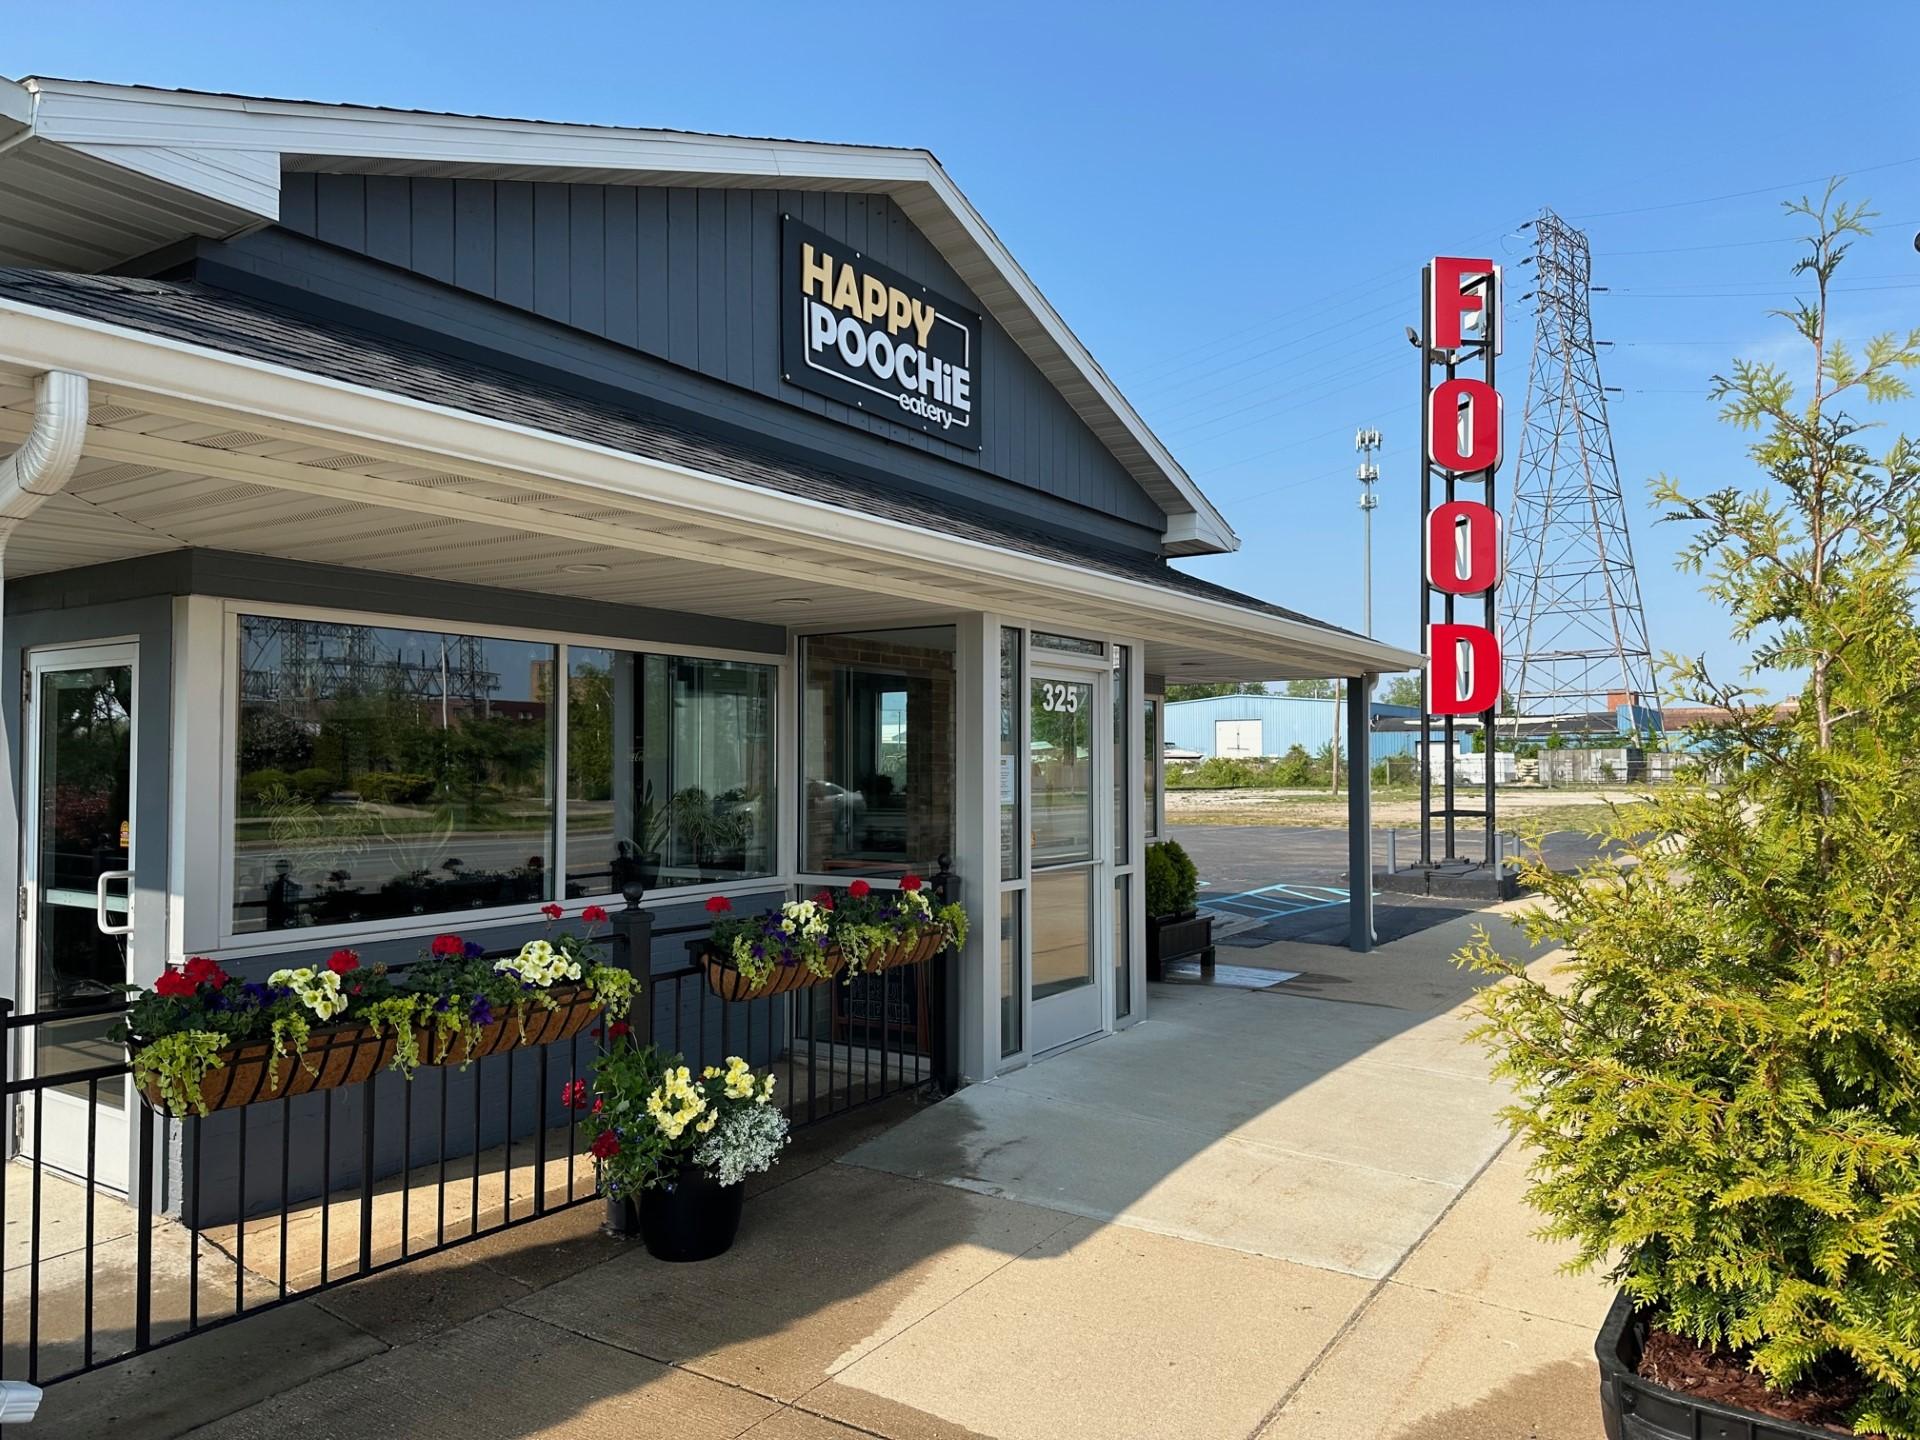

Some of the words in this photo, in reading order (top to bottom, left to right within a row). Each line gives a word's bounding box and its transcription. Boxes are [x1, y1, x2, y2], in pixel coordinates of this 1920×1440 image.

[802, 242, 935, 348] HAPPY
[899, 393, 953, 429] eatery
[1428, 256, 1501, 715] FOOD
[1042, 683, 1078, 713] 325
